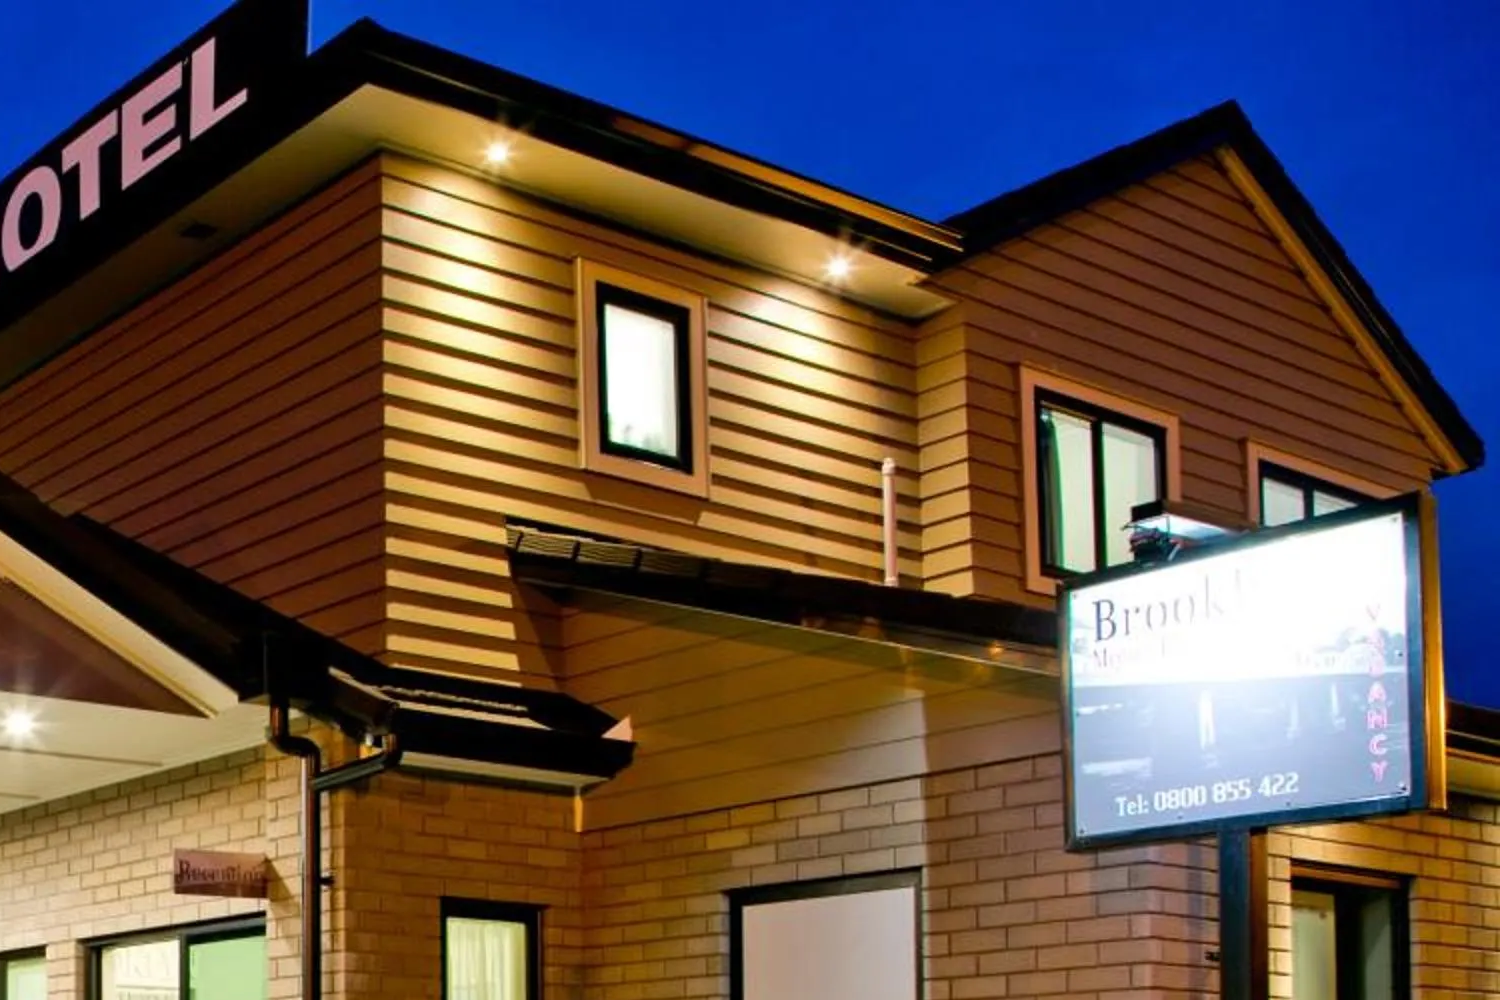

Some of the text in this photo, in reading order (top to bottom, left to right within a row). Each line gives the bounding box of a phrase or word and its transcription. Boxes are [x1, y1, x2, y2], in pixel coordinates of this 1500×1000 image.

[1114, 771, 1299, 817] Tel: 0800 855 422
